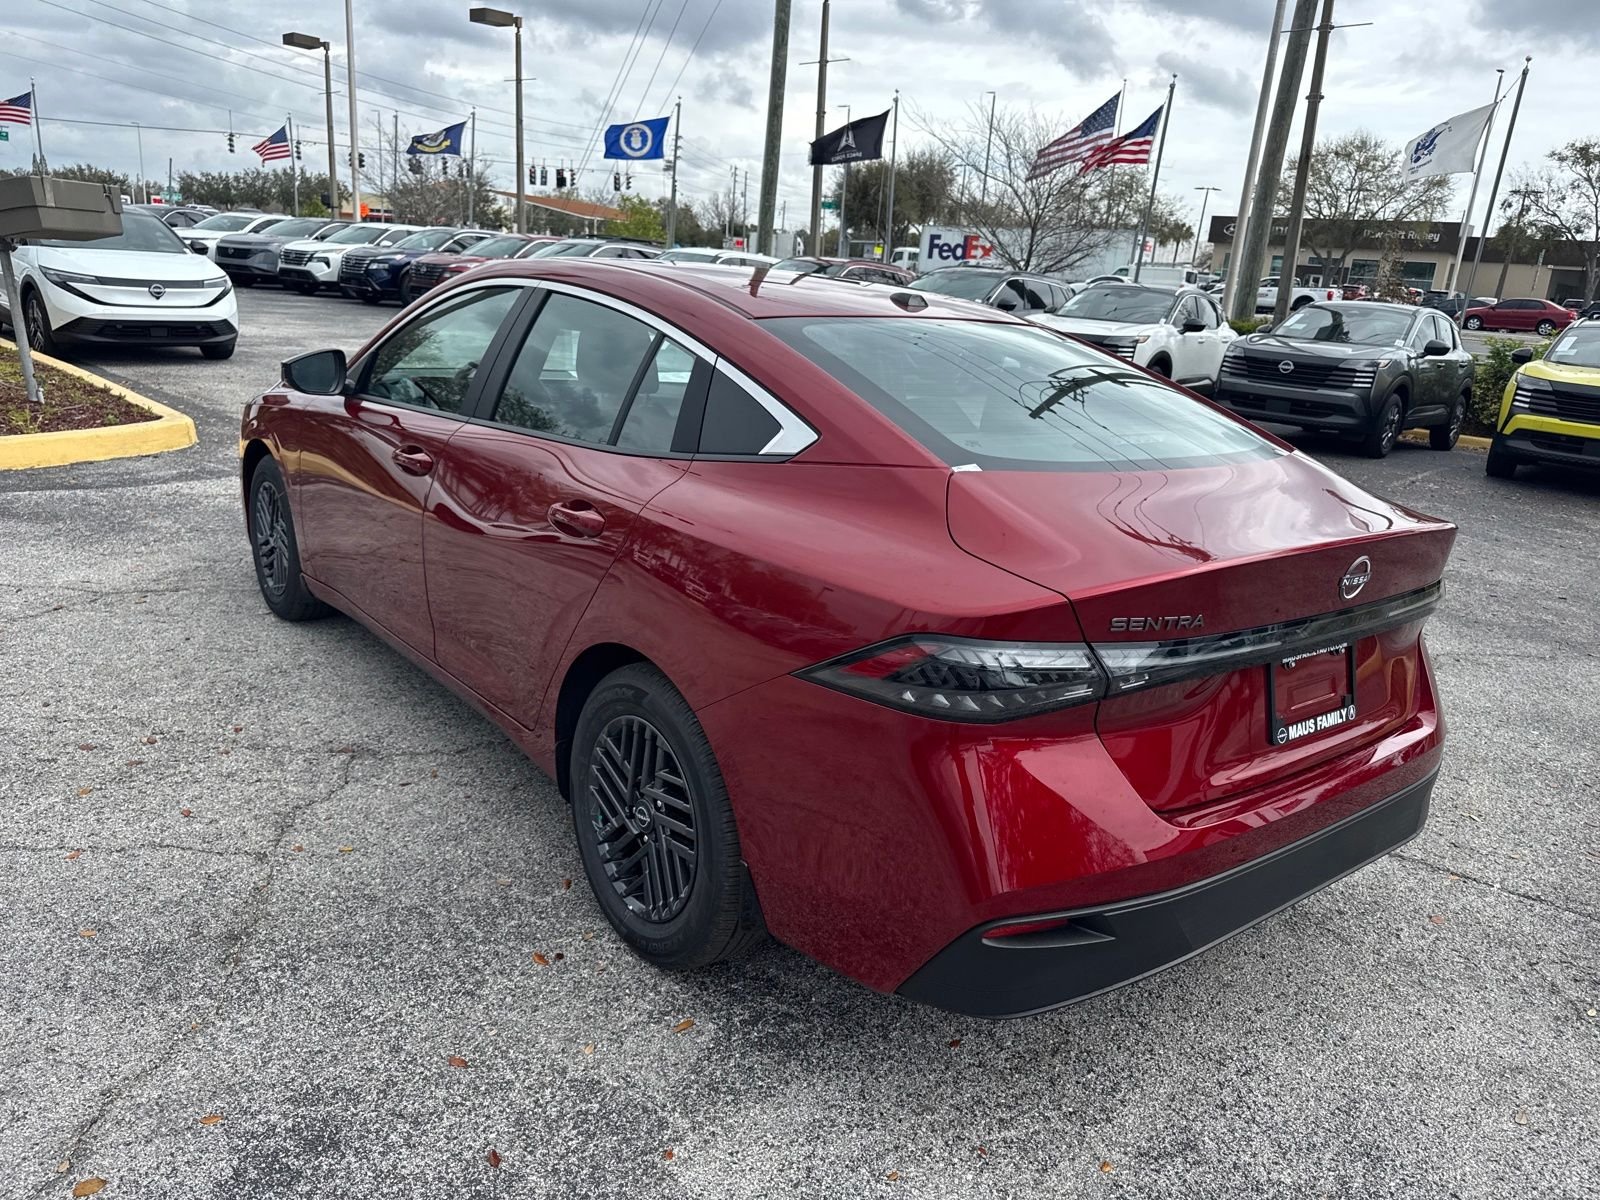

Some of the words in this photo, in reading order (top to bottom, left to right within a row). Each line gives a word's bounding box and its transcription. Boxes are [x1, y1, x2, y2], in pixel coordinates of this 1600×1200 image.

[927, 234, 993, 261] FedEx
[1342, 575, 1371, 586] NISSA
[1110, 614, 1204, 632] SENTRA
[1289, 719, 1315, 740] MAUS
[1317, 708, 1347, 730] FAMILY
